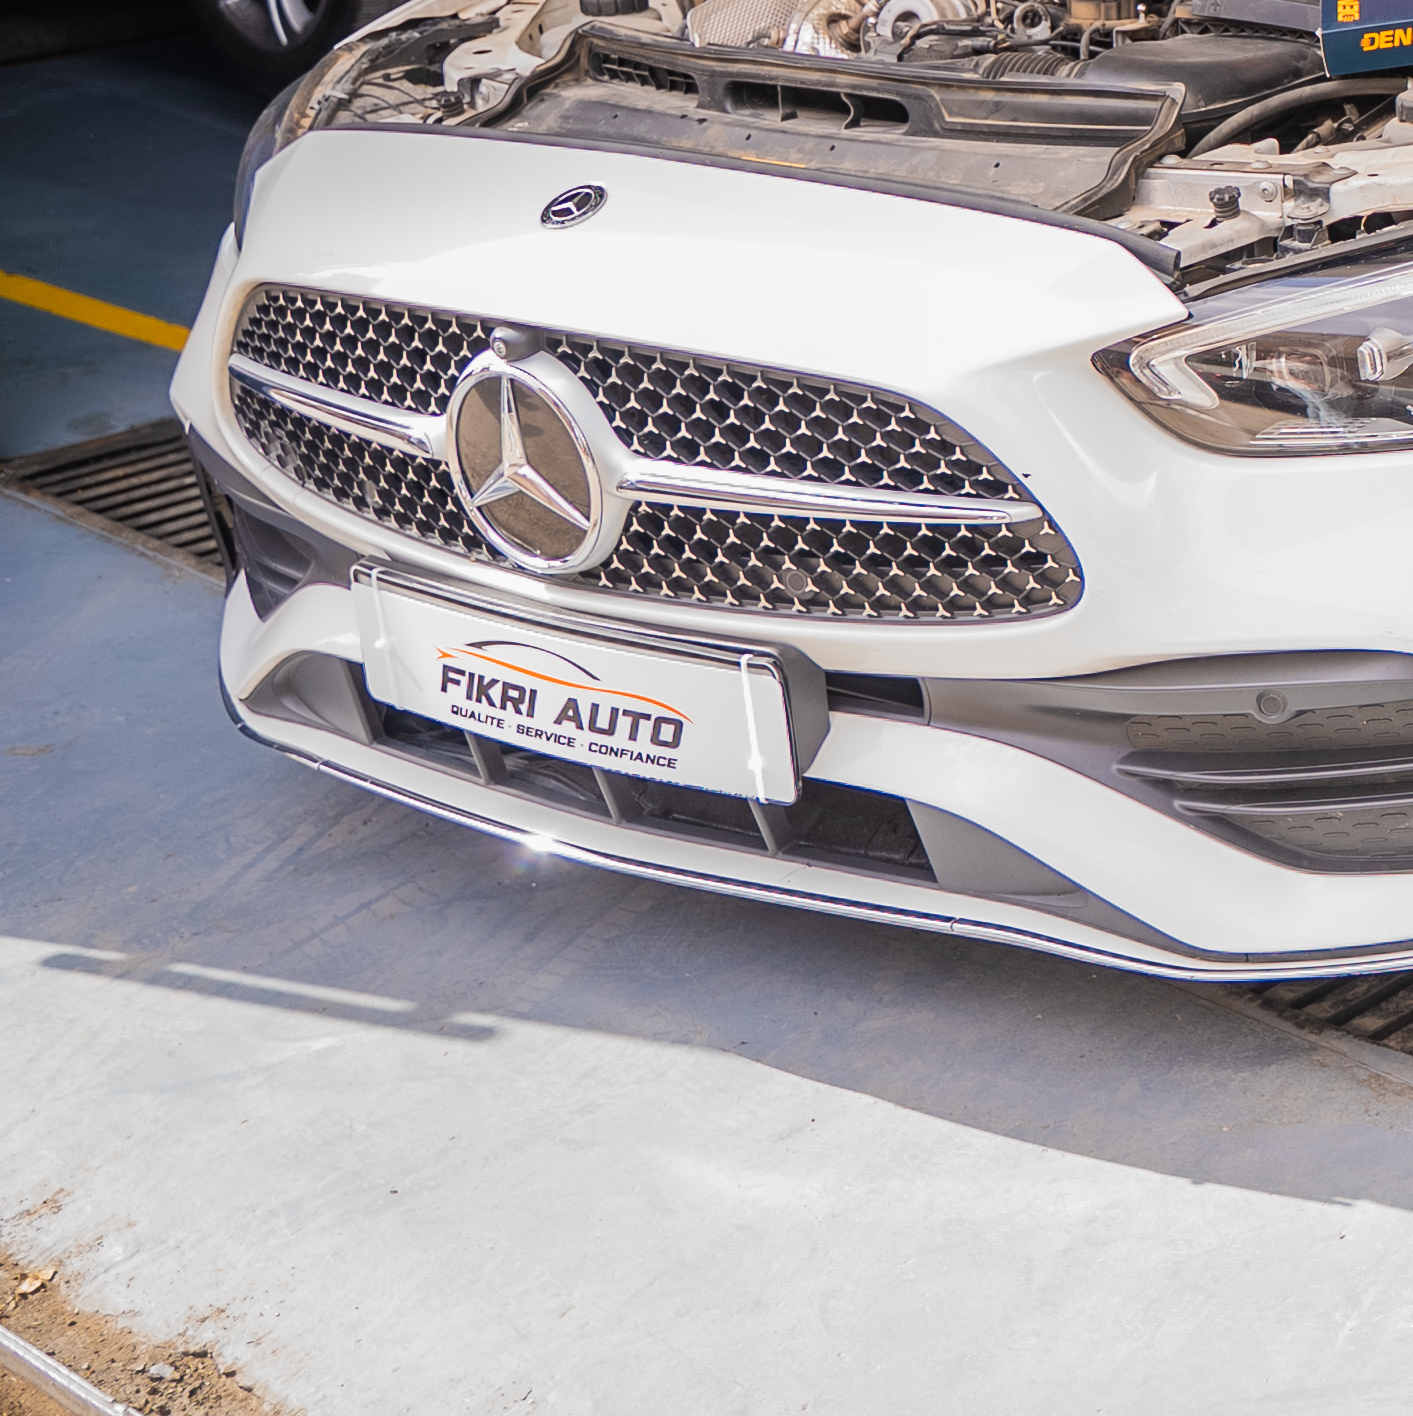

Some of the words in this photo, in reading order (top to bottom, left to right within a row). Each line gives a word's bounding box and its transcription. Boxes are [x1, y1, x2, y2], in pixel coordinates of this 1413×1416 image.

[440, 664, 538, 718] FIKRI
[553, 697, 684, 749] AUTO
[451, 704, 505, 729] QUALITE
[516, 724, 576, 748] SERVICE
[588, 741, 678, 769] CONFIANCE
